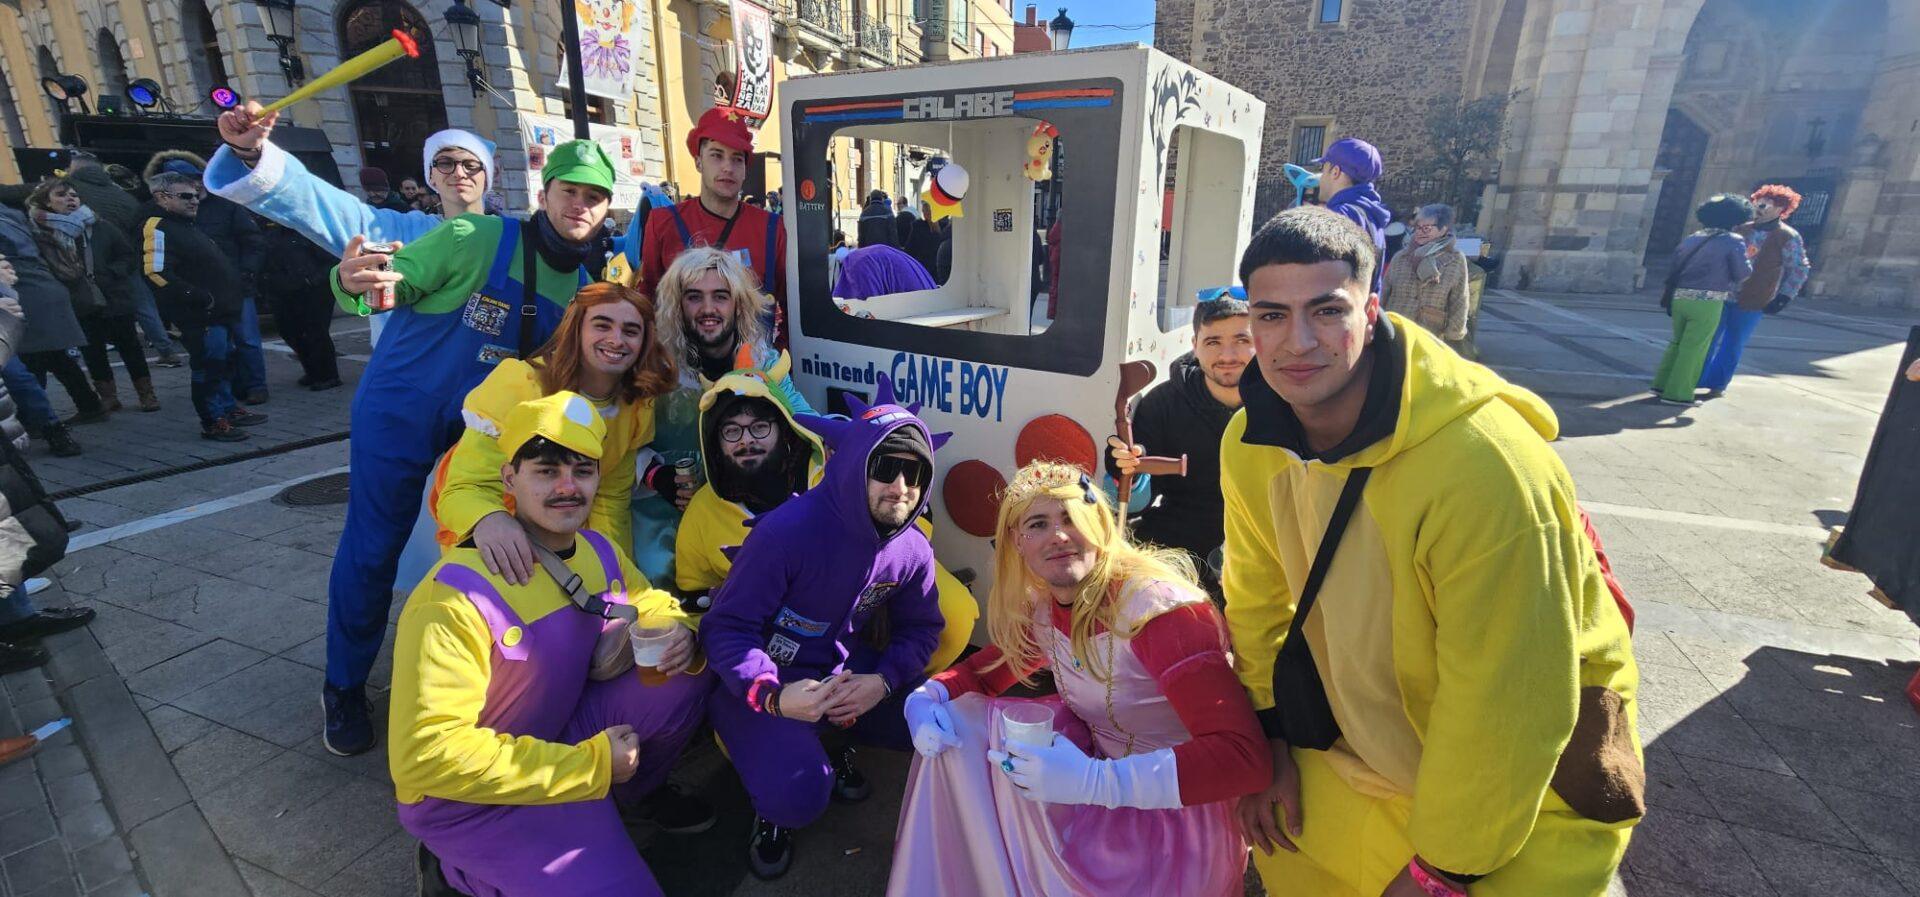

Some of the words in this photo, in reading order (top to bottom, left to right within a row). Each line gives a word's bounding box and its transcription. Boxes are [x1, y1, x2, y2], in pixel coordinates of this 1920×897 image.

[903, 91, 1014, 119] CALABE
[800, 202, 825, 210] BATTERY
[891, 352, 953, 413] GAME
[960, 362, 1009, 422] BOY
